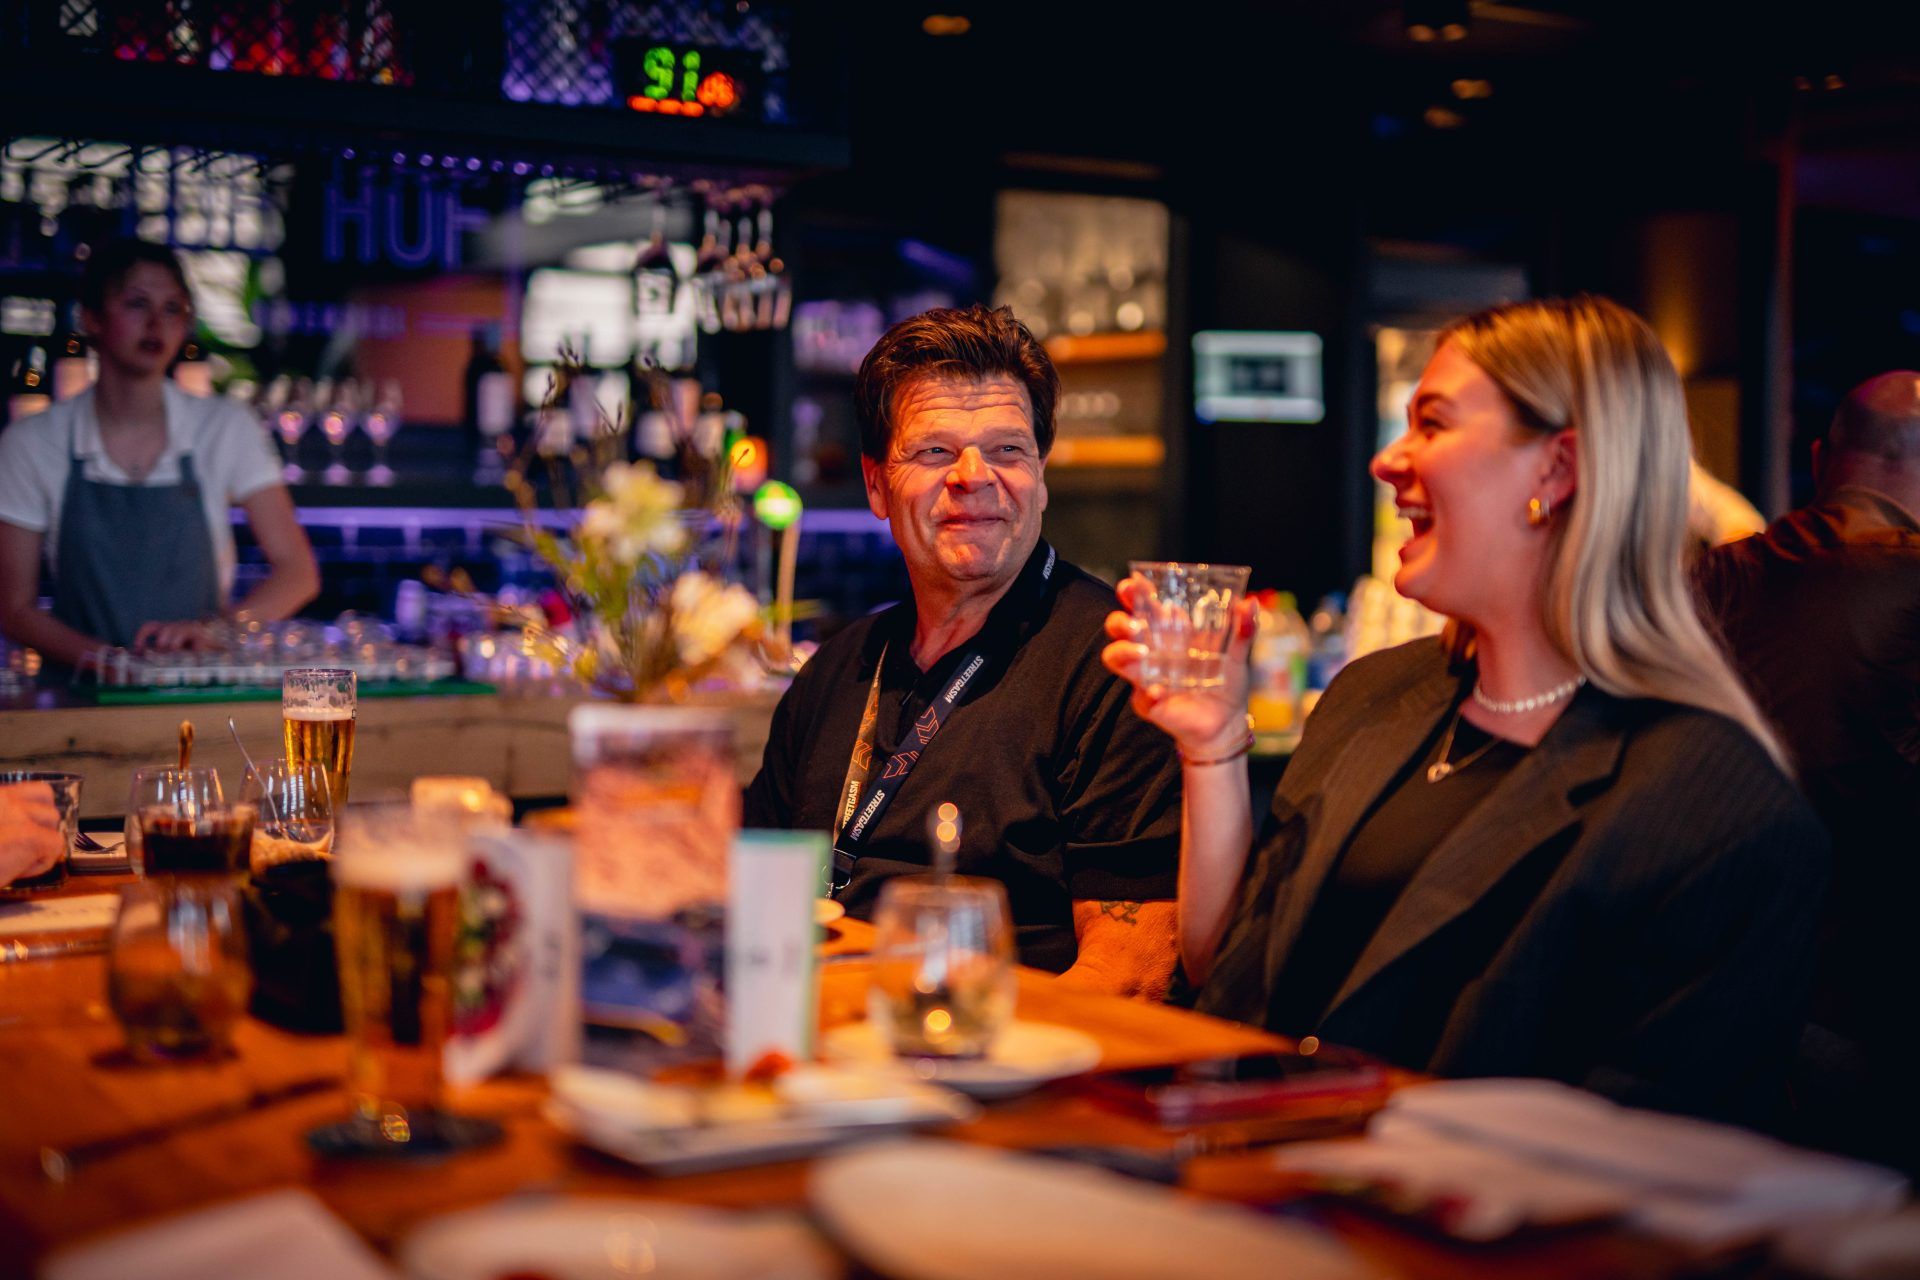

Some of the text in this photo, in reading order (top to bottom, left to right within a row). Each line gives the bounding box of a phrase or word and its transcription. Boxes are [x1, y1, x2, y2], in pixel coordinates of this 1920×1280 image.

[944, 655, 984, 704] STREETGASM
[842, 780, 860, 829] TREETGASM
[850, 789, 886, 841] STREETGASM
